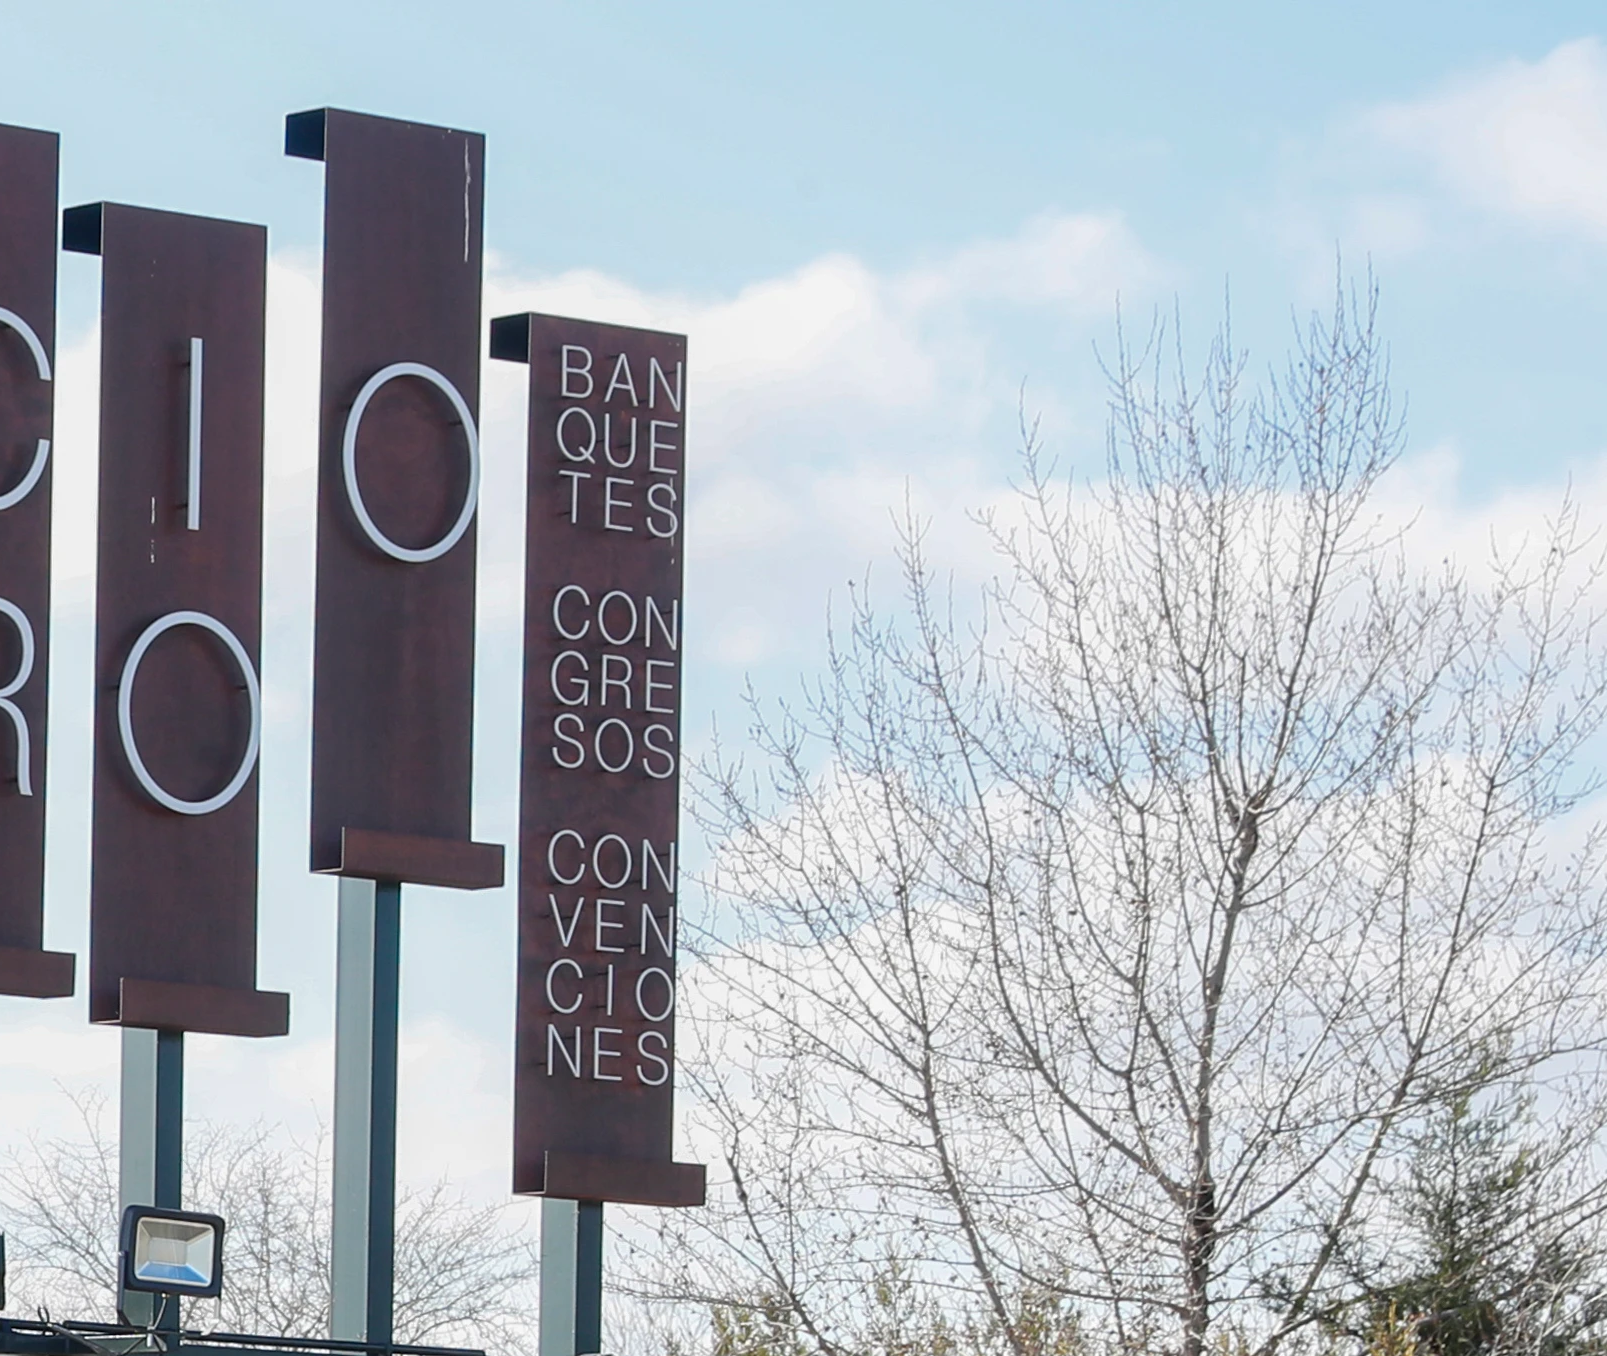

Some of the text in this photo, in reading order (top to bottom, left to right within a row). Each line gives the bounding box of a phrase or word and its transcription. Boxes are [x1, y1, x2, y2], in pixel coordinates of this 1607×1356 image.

[560, 344, 683, 413] BAN
[556, 406, 679, 475] QUE
[558, 469, 679, 538] TES
[552, 584, 678, 651] CON
[550, 649, 675, 714] GRE
[551, 713, 675, 779] SOS
[547, 828, 676, 894] CON
[548, 893, 675, 958] VEN
[545, 957, 675, 1022] CIO
[546, 1023, 669, 1087] NES
